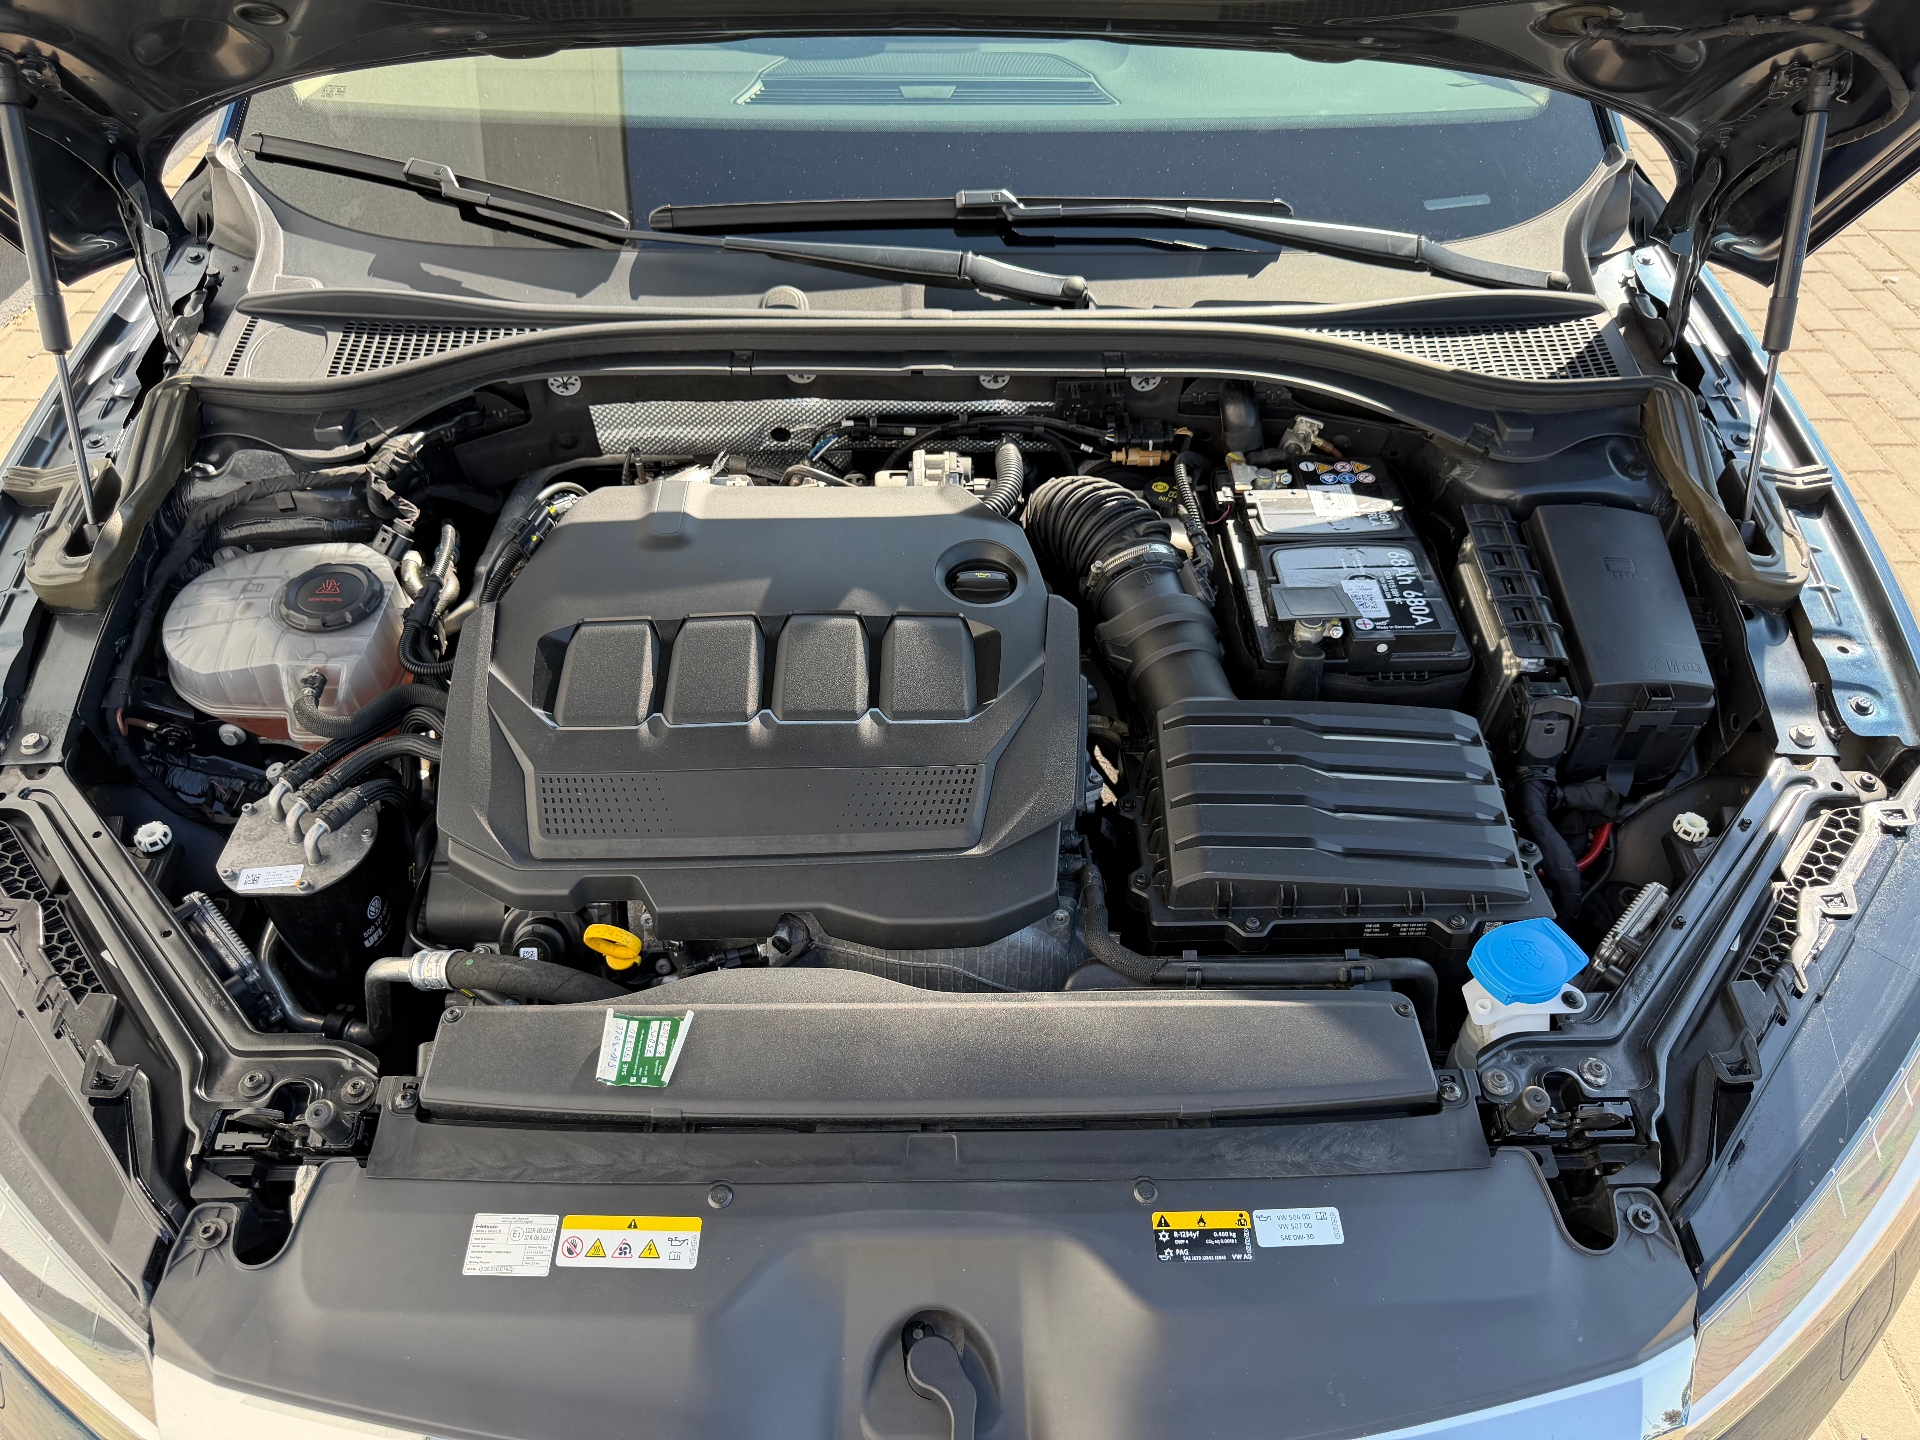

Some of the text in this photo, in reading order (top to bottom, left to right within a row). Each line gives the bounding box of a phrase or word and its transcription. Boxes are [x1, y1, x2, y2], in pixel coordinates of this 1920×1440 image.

[1387, 551, 1434, 626] 68Ah 680A
[364, 927, 383, 947] UFI
[1174, 1231, 1199, 1239] R-1234yf
